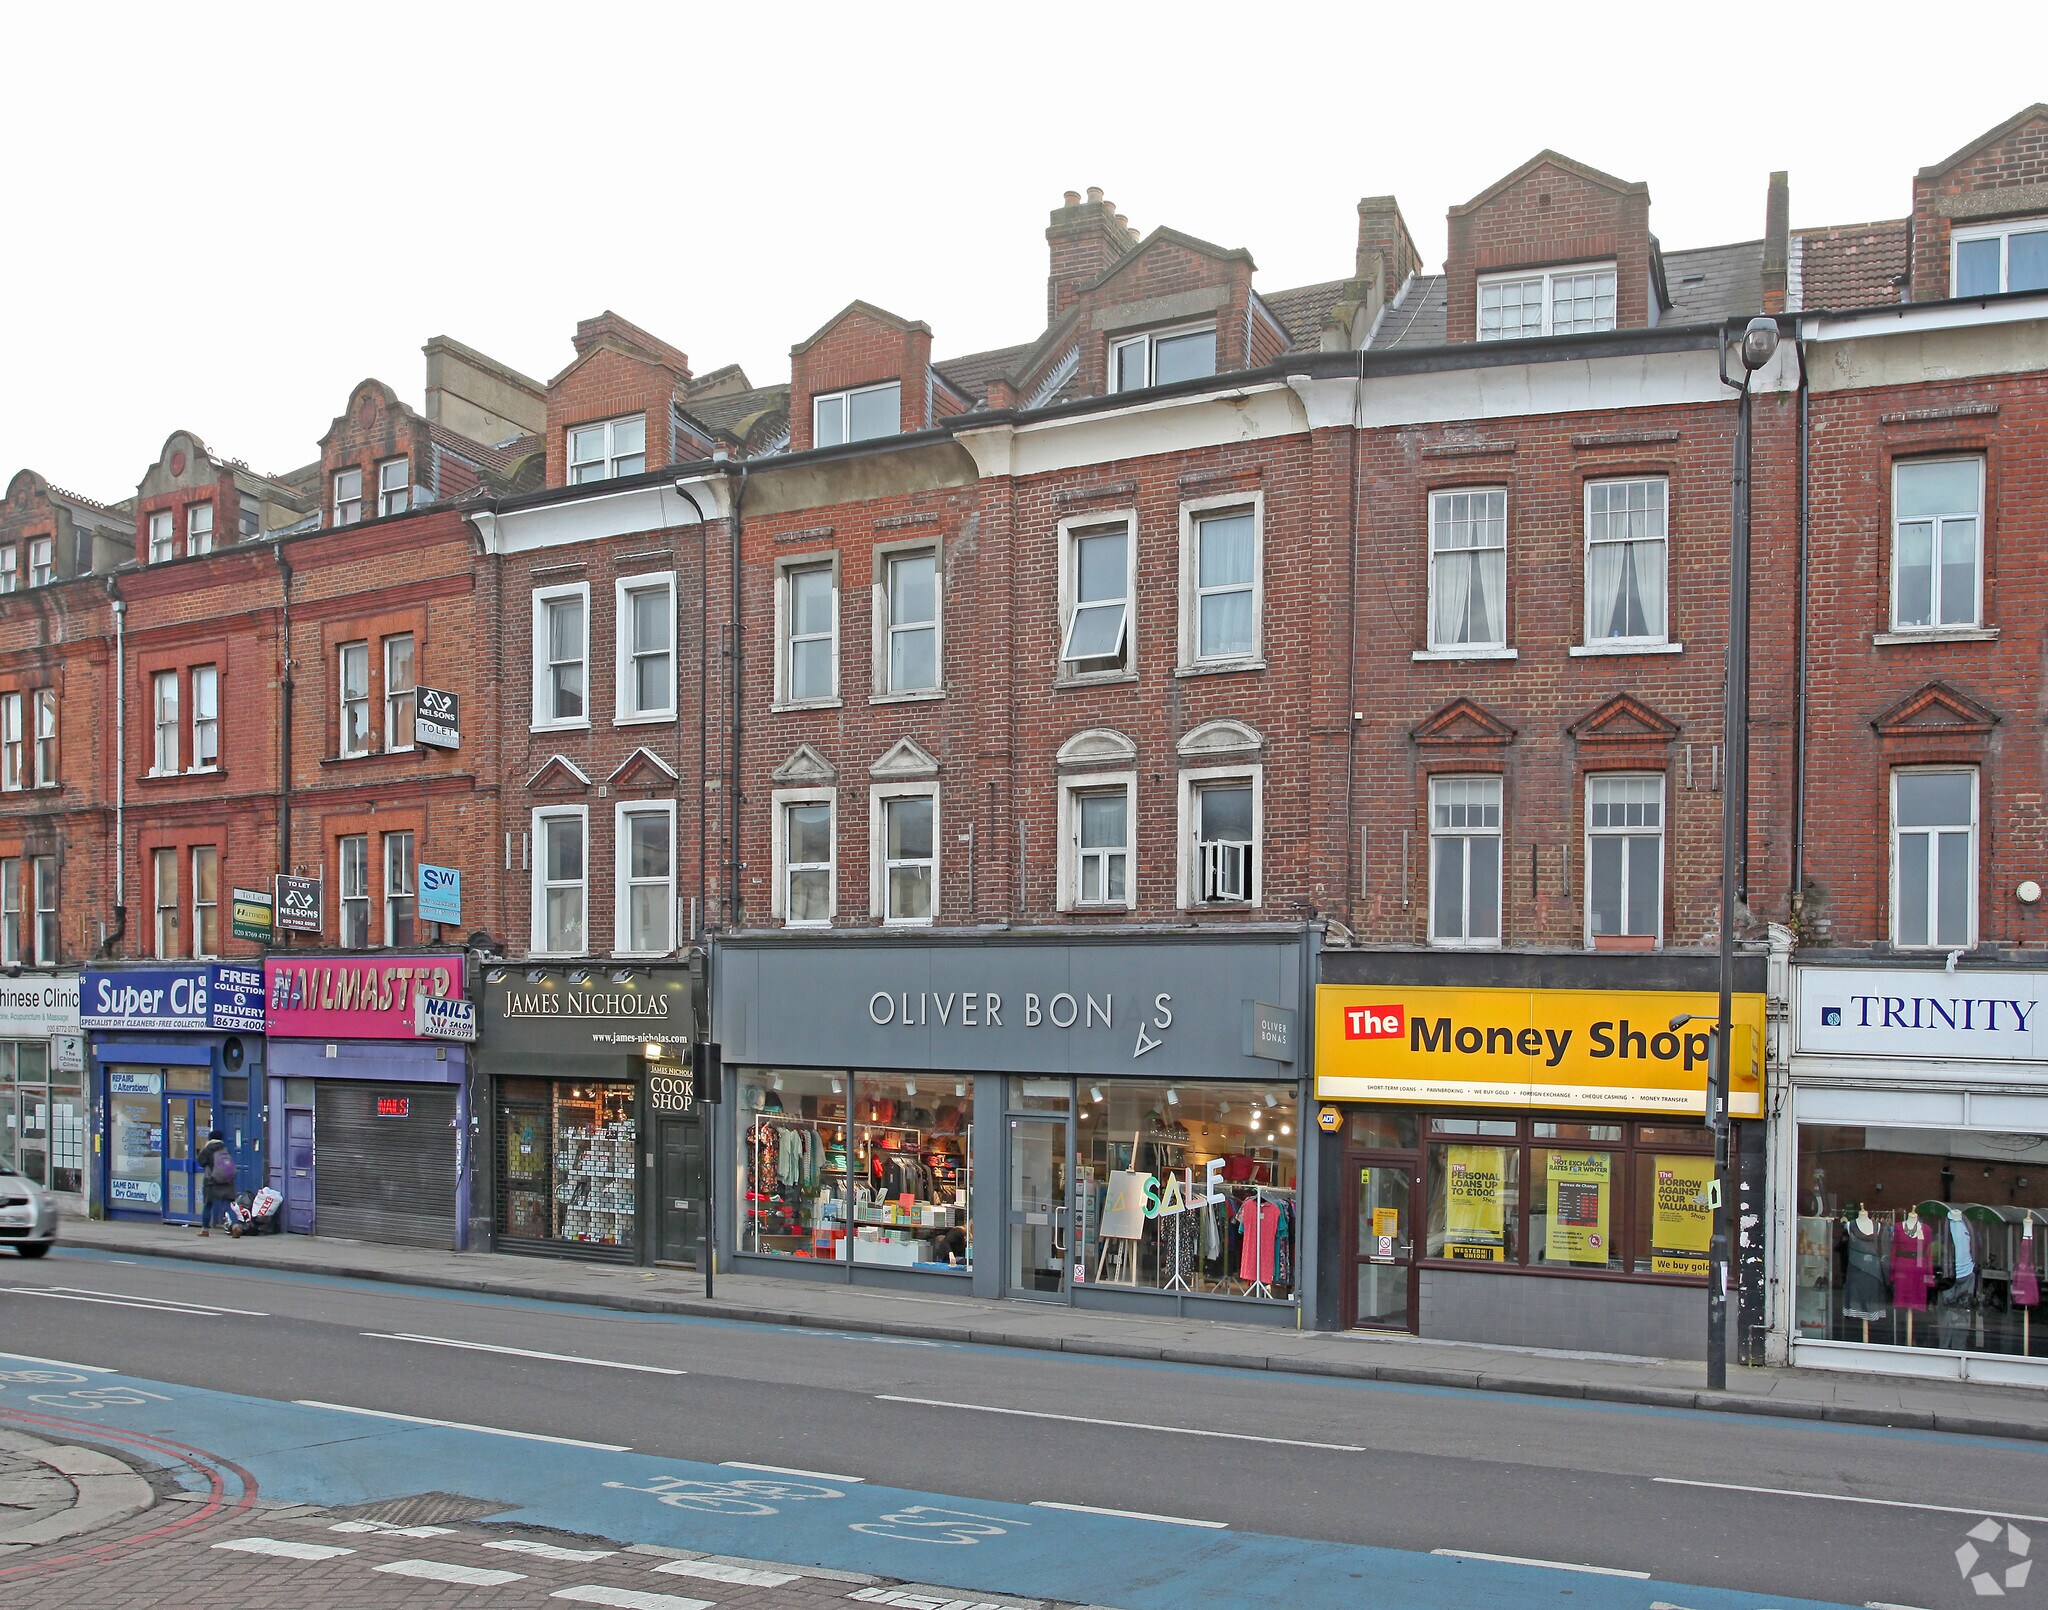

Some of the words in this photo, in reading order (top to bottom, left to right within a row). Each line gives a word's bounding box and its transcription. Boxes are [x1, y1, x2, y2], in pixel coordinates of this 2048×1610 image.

[420, 708, 455, 721] NELSONS
[422, 722, 434, 732] TO
[436, 726, 454, 736] LET
[424, 869, 454, 890] SW
[280, 907, 318, 918] NELSONS
[220, 969, 260, 986] FREE
[214, 982, 265, 995] COLLECTION
[44, 988, 79, 1007] Clinic
[97, 978, 164, 1017] Super
[235, 994, 245, 1004] &
[503, 990, 559, 1018] JAMES
[568, 992, 668, 1015] NICHOLAS
[214, 1004, 264, 1018] DELIVERY
[425, 999, 473, 1019] NAILS
[869, 991, 1002, 1027] OLIVER
[1850, 995, 2038, 1032] TRINITY
[10, 1013, 41, 1022] Acupuncture
[47, 1014, 69, 1022] Massage
[216, 1017, 240, 1028] 8673
[1348, 1010, 1398, 1034] The
[1262, 1020, 1286, 1033] OLIVER
[592, 1032, 687, 1044] www.james-nicholas.com
[1262, 1031, 1286, 1044] BONAS
[1410, 1017, 1573, 1067] Money
[1589, 1020, 1709, 1071] Shop
[112, 1074, 134, 1082] REPAIRS
[118, 1083, 148, 1092] Alterations
[651, 1077, 693, 1096] COOK
[378, 1098, 406, 1114] NAILS
[652, 1093, 692, 1111] SHOP
[1452, 1172, 1500, 1181] PERSONAL
[113, 1181, 127, 1190] SAME
[1142, 1158, 1226, 1219] SALE
[1452, 1179, 1482, 1188] LOANS
[1485, 1180, 1497, 1188] UP
[1659, 1179, 1702, 1188] BORROW
[115, 1190, 126, 1198] Dry
[127, 1191, 147, 1200] Cleaning
[1452, 1188, 1463, 1196] TO
[1466, 1188, 1495, 1197] £1000
[1658, 1186, 1700, 1196] AGAINST
[1658, 1194, 1685, 1203] YOUR
[1658, 1202, 1710, 1213] VALUABLES
[1658, 1260, 1670, 1268] We
[1673, 1261, 1689, 1271] buy
[27, 1386, 173, 1410] CS7
[848, 1506, 1032, 1545] CS7
